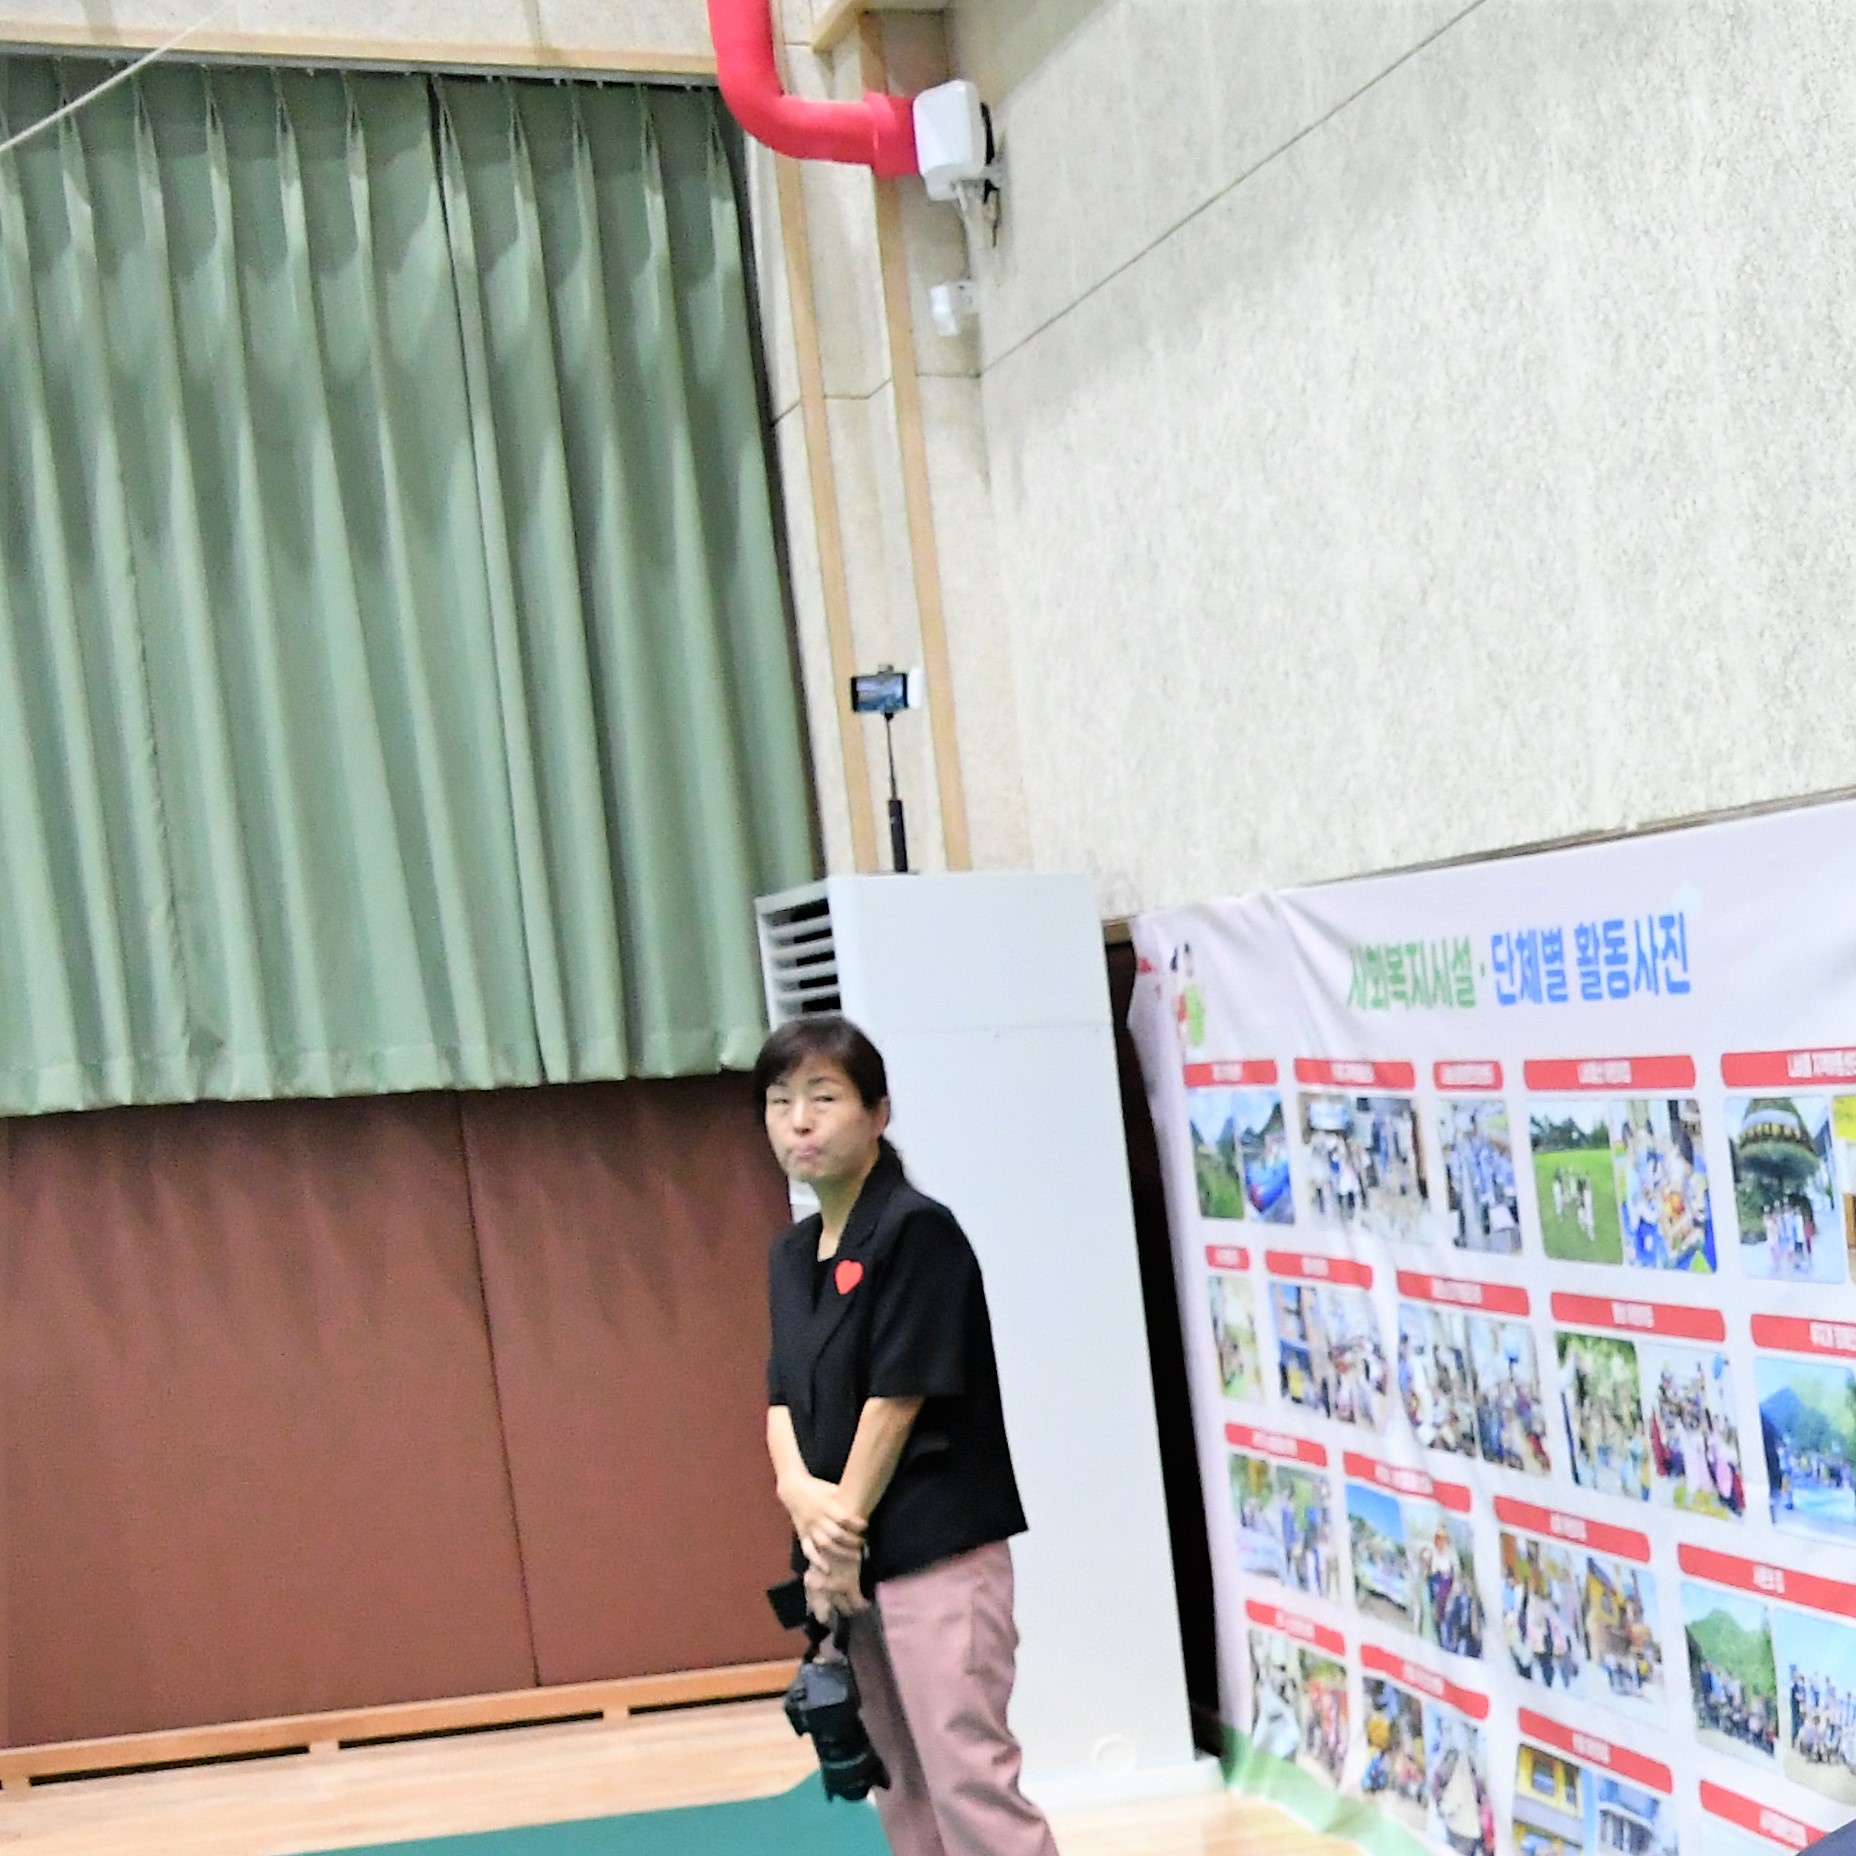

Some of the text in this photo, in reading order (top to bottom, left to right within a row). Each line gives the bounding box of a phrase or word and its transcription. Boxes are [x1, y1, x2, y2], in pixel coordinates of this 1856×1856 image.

[1348, 935, 1477, 1010] 사회복지시설
[1490, 925, 1570, 1007] 단체별
[1574, 910, 1692, 1001] 활동사진
